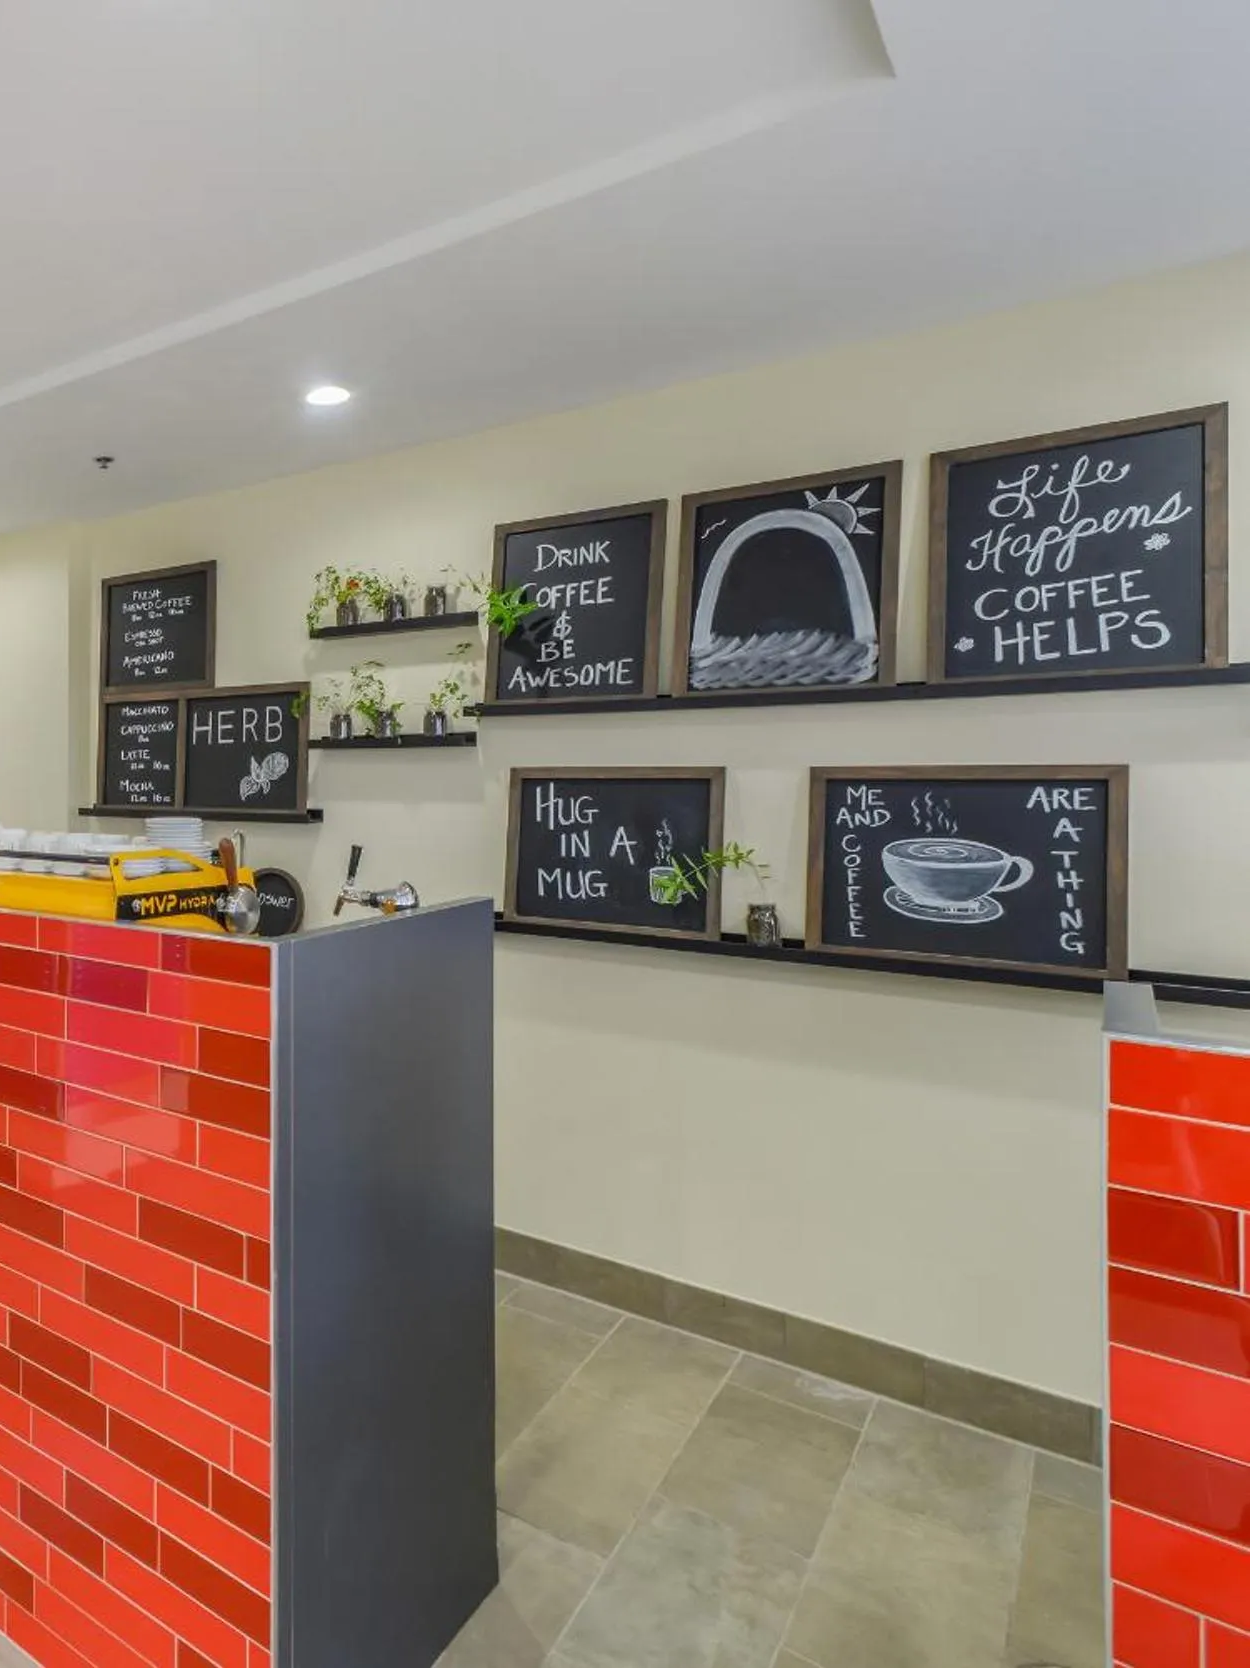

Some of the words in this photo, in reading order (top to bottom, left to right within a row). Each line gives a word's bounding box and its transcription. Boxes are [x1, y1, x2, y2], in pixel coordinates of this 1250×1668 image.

[988, 454, 1131, 523] Life
[965, 491, 1193, 577] Happens
[534, 541, 611, 572] DRINK
[974, 569, 1151, 621] COFFEE
[536, 639, 575, 663] BE
[994, 609, 1172, 665] HELPS
[508, 658, 634, 692] AWESOME
[192, 705, 283, 745] HERB
[120, 749, 151, 761] LATTE
[535, 781, 600, 831] HUG
[846, 785, 885, 811] ME
[1025, 786, 1097, 813] ARE
[835, 807, 892, 829] AND
[1052, 817, 1084, 843] A
[560, 829, 591, 858] IN
[609, 825, 638, 866] A
[537, 867, 609, 900] MUG
[840, 833, 867, 939] COFFEE
[140, 894, 178, 916] MVP
[1050, 850, 1085, 955] THING
